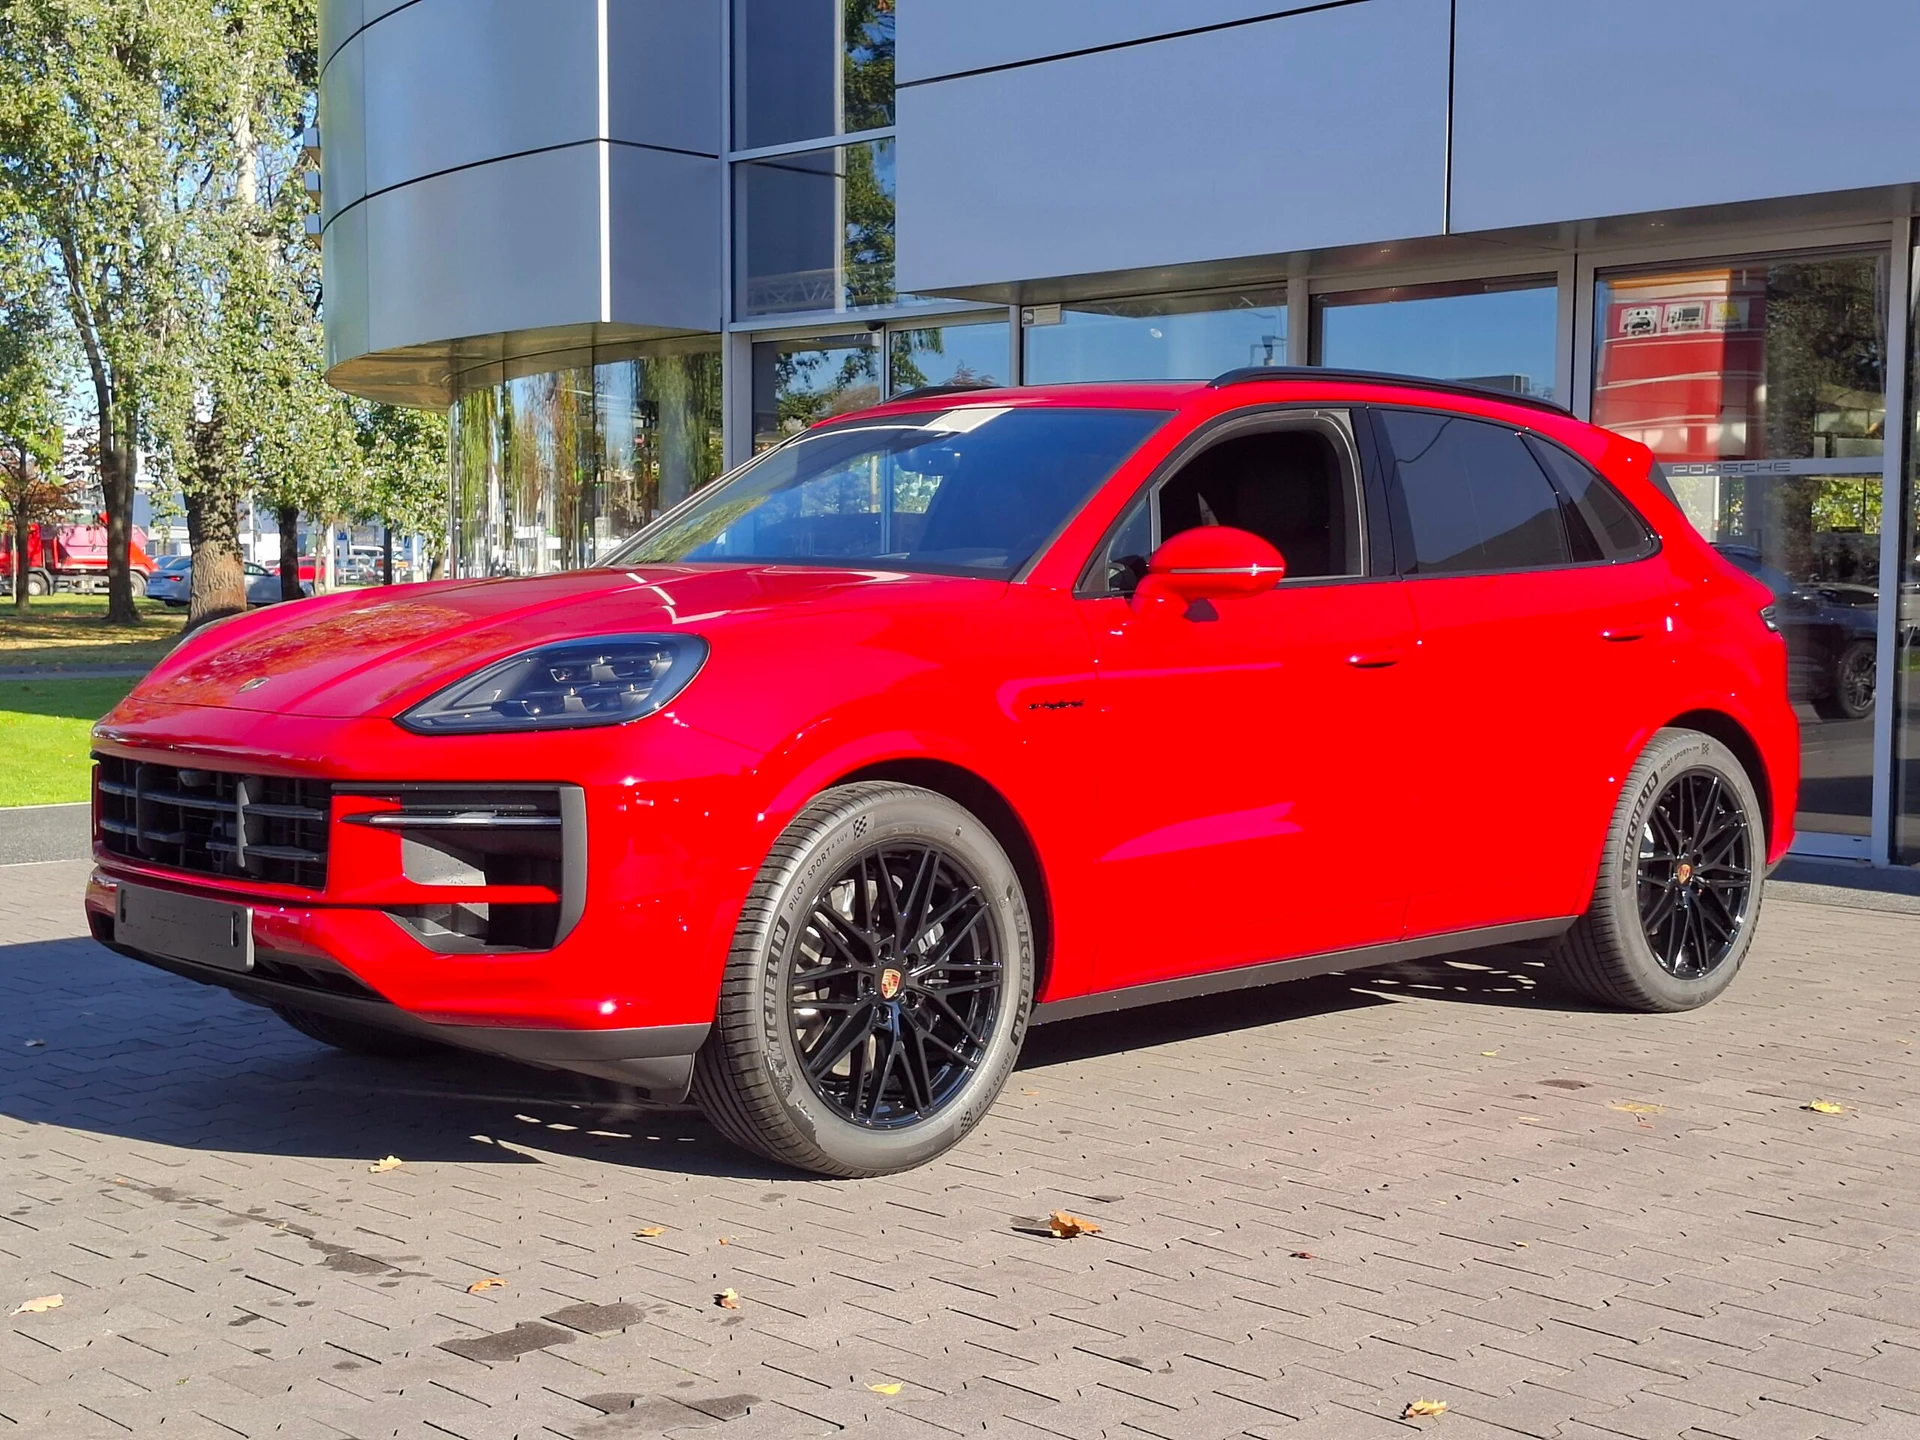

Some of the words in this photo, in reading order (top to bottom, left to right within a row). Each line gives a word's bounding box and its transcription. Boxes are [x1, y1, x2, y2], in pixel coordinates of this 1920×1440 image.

[1672, 462, 1791, 474] PORSCHE
[1624, 775, 1657, 861] MICHELIN
[788, 879, 807, 911] PILOT
[807, 847, 831, 879] SPORT
[837, 832, 848, 844] SUV
[764, 922, 788, 1060] MICHELIN
[1013, 914, 1030, 1040] MICHELIN
